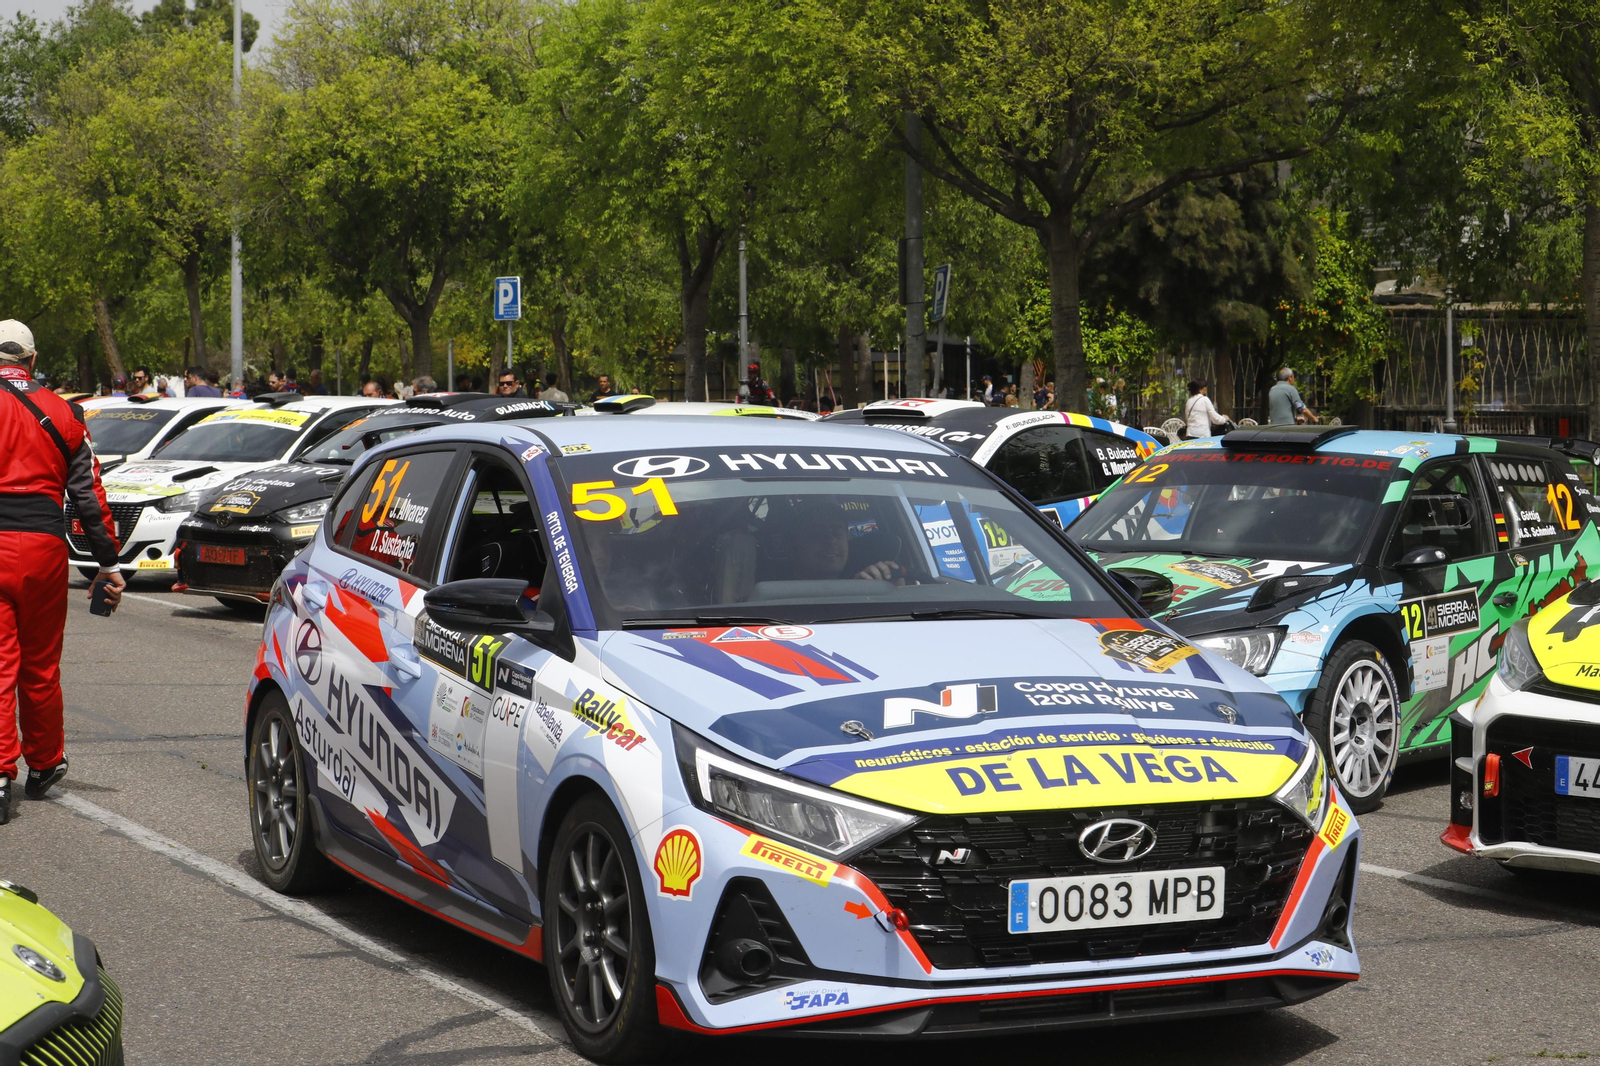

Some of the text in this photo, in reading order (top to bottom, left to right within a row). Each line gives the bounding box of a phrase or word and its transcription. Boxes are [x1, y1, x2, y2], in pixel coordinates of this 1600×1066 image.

[499, 282, 514, 316] P
[384, 406, 476, 421] Caetano Auto
[495, 401, 549, 416] GLASSBACK
[718, 453, 949, 478] HYUNDAI
[1096, 446, 1137, 460] B. Bulacia
[1150, 452, 1394, 472] WWW.ZELTE-GOETTIG.DE
[1102, 462, 1112, 476] G.
[1124, 463, 1170, 484] 12
[240, 484, 267, 492] Auto
[252, 478, 295, 488] Caetano
[361, 459, 411, 527] 51
[398, 493, 429, 524] Álvarez
[571, 477, 679, 522] 51
[1546, 483, 1581, 531] 12
[1520, 510, 1541, 523] Göttig
[983, 521, 1008, 548] 15
[1531, 525, 1557, 537] Schmidt
[370, 529, 416, 560] D. Sustacha
[546, 511, 579, 595] AYTO. DE TEVERGA
[140, 561, 167, 569] PIRELLI
[350, 574, 394, 605] HYUNDAI
[1401, 603, 1424, 639] 12
[1437, 600, 1470, 616] SIERRA
[1438, 610, 1478, 628] MORENA
[425, 630, 466, 667] MORENA
[471, 634, 504, 689] 51
[1575, 664, 1600, 677] Ma
[1013, 680, 1199, 700] Copa Hyundai
[1027, 692, 1176, 712] i20N Rallye
[574, 687, 647, 752] Rally car
[294, 698, 356, 802] Asturdai
[327, 661, 441, 840] HYUNDAI
[855, 745, 953, 768] neumáticos
[965, 735, 1035, 753] estación
[1037, 732, 1057, 744] de
[1059, 730, 1121, 744] servicio
[1135, 733, 1196, 747] gasóleos
[1211, 737, 1276, 752] domicilio
[945, 752, 1239, 797] DE LA VEGA
[1560, 778, 1566, 786] E
[1323, 808, 1347, 846] PIRELLI
[750, 840, 828, 880] PIRELLI
[1039, 875, 1216, 924] 0083 MPB
[1015, 912, 1024, 924] E
[790, 992, 850, 1010] FAPA
